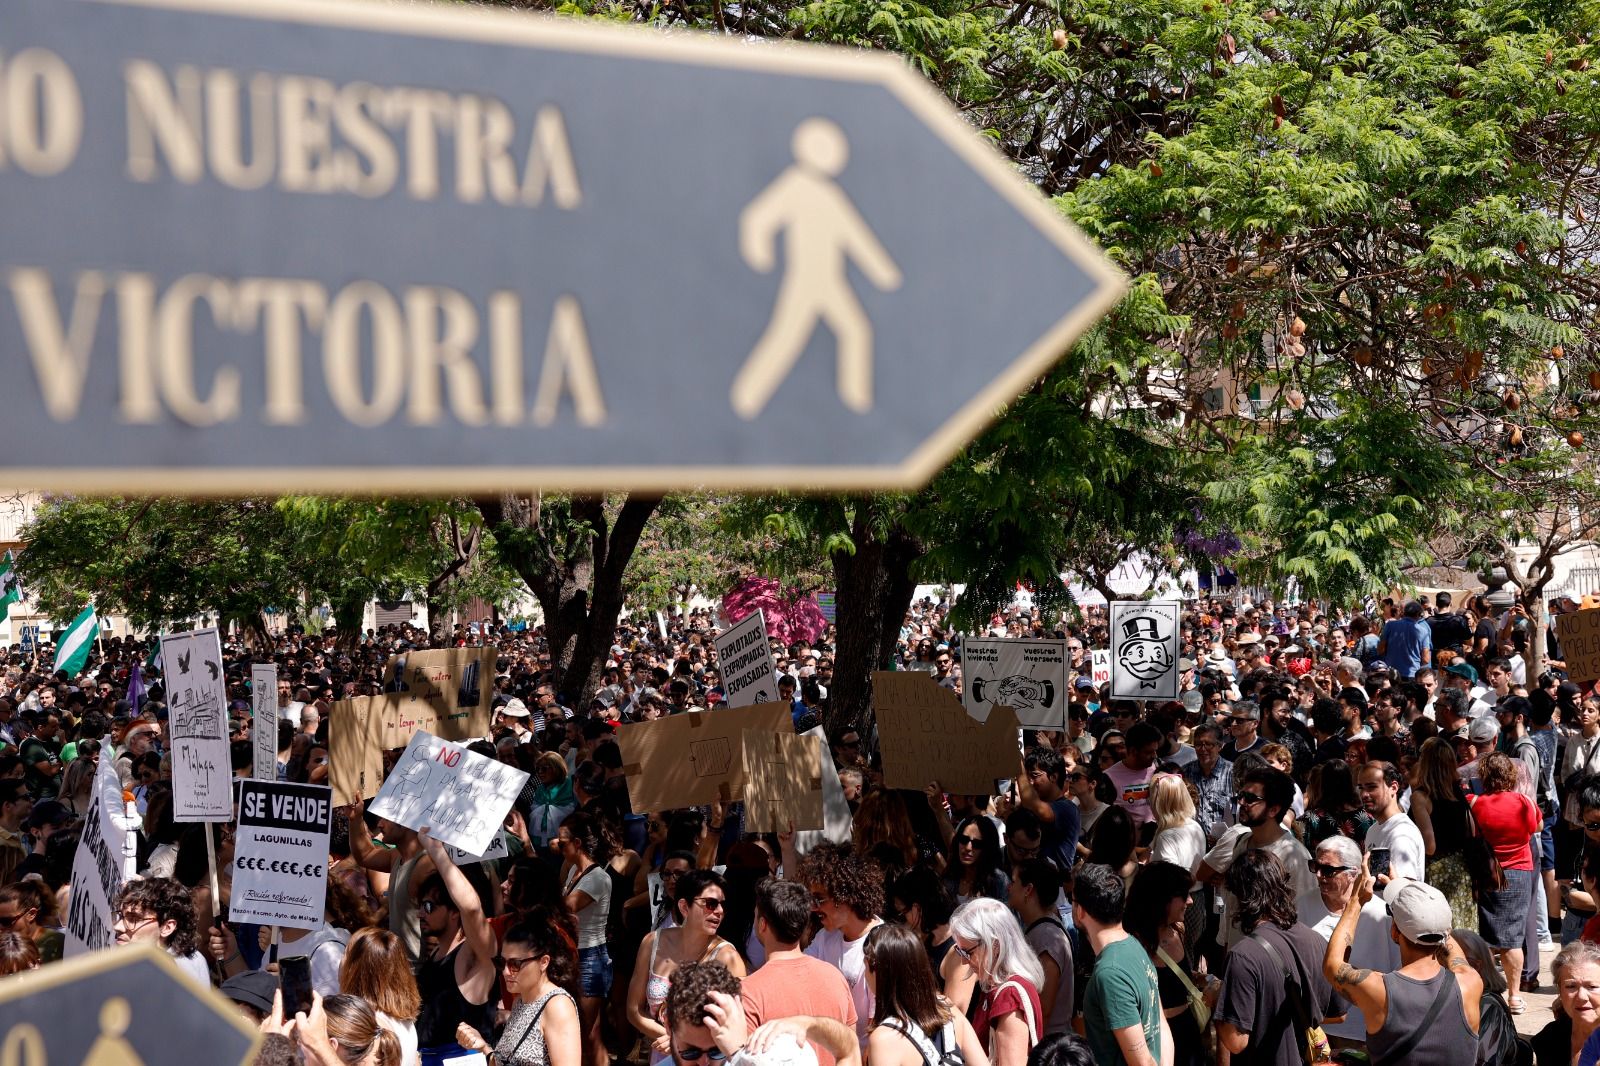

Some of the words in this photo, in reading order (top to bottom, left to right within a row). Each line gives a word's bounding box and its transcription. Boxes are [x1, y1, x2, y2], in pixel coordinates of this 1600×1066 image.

[124, 57, 583, 211] NUESTRA
[8, 264, 607, 429] VICTORIA
[1561, 615, 1581, 636] NO
[1563, 633, 1600, 658] MALA
[1094, 670, 1109, 682] NO
[1569, 661, 1588, 679] EN
[435, 746, 462, 768] NO
[244, 791, 267, 818] SE
[271, 793, 328, 825] VENDE
[253, 833, 313, 848] LAGUNILLAS
[236, 856, 322, 878] €€€.€€€,€€
